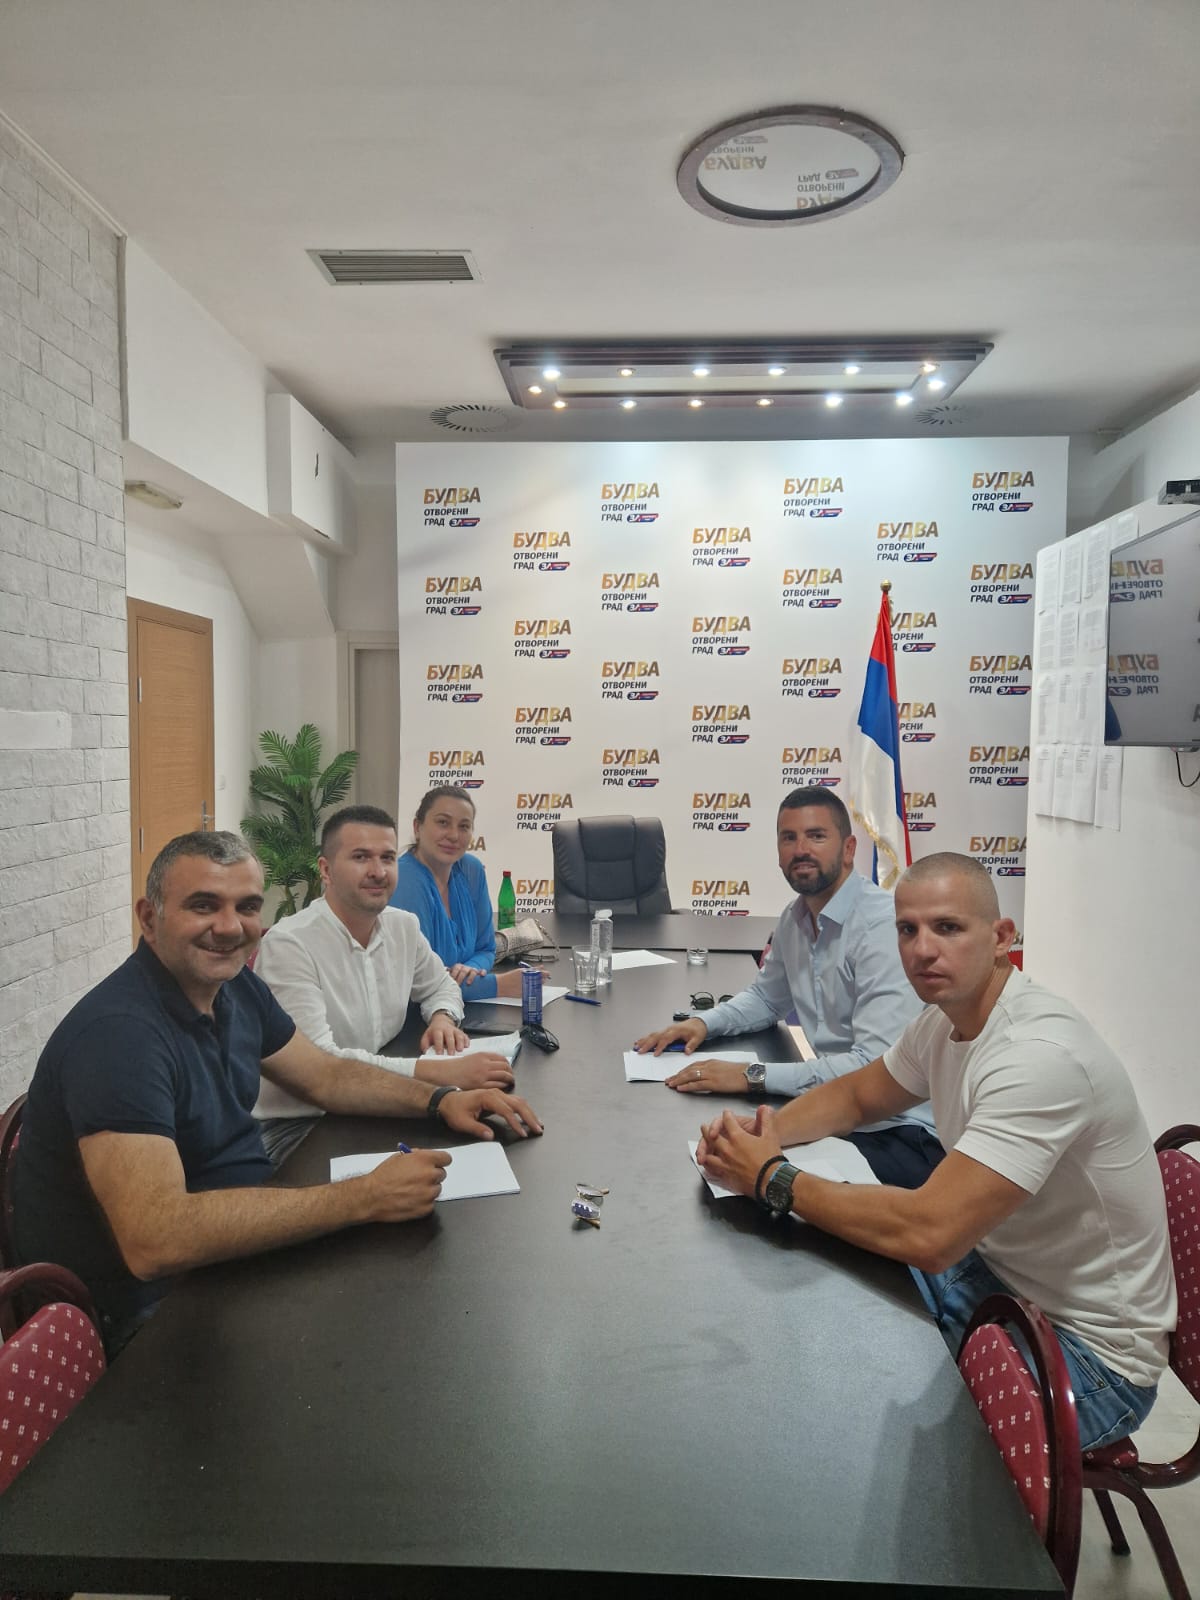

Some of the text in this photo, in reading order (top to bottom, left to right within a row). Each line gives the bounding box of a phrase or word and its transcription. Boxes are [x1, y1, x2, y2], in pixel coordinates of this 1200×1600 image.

[973, 471, 1034, 491] БУДВА
[784, 477, 843, 497] БУДВА
[424, 487, 481, 507] БУДВА
[601, 483, 659, 502] БУДВА
[972, 492, 1021, 501] ОТВОРЕНИ
[784, 498, 830, 507] ОТВОРЕНИ
[424, 508, 468, 516] ОТВОРЕНИ
[601, 503, 647, 512] ОТВОРЕНИ
[972, 503, 994, 512] ГРАД
[601, 513, 622, 522] ГРАД
[784, 509, 805, 517] ГРАД
[424, 518, 445, 527] ГРАД
[877, 521, 938, 541] БУДВА
[513, 532, 570, 550] БУДВА
[692, 527, 751, 546] БУДВА
[877, 542, 925, 551] ОТВОРЕНИ
[513, 552, 558, 560] ОТВОРЕНИ
[693, 548, 738, 556] ОТВОРЕНИ
[877, 553, 899, 561] ГРАД
[513, 562, 534, 571] ГРАД
[692, 558, 714, 566] ГРАД
[783, 568, 843, 587] БУДВА
[971, 563, 1034, 583] БУДВА
[425, 576, 482, 595] БУДВА
[602, 573, 659, 592] БУДВА
[783, 589, 830, 597] ОТВОРЕНИ
[970, 584, 1019, 593] ОТВОРЕНИ
[426, 597, 470, 605] ОТВОРЕНИ
[601, 593, 647, 601] ОТВОРЕНИ
[970, 594, 993, 603] ГРАД
[601, 603, 623, 611] ГРАД
[783, 599, 804, 607] ГРАД
[426, 606, 446, 615] ГРАД
[692, 616, 751, 635] БУДВА
[891, 612, 937, 631] УДВА
[514, 620, 571, 638] БУДВА
[692, 636, 738, 645] ОТВОРЕНИ
[892, 632, 924, 641] ОРЕНИ
[514, 649, 535, 658] ГРАД
[692, 646, 713, 655] ГРАД
[782, 658, 842, 677] БУДВА
[970, 655, 1032, 674] БУДВА
[427, 664, 483, 683] БУДВА
[602, 661, 659, 680] БУДВА
[782, 678, 829, 687] ОТВОРЕНИ
[969, 675, 1019, 684] ОТВОРЕНИ
[427, 684, 471, 692] ОТВОРЕНИ
[602, 681, 647, 689] ОТВОРЕНИ
[782, 688, 803, 697] ГРАД
[969, 686, 992, 694] ГРАД
[427, 693, 448, 702] ГРАД
[602, 691, 623, 699] ГРАД
[692, 705, 750, 724] БУДВА
[898, 702, 936, 721] ДВА
[515, 707, 572, 726] БУДВА
[515, 727, 560, 735] ОТВОРЕНИ
[692, 725, 738, 733] ОТВОРЕНИ
[515, 736, 536, 744] ГРАД
[692, 734, 713, 743] ГРАД
[429, 750, 484, 769] БУДВА
[603, 749, 660, 767] БУДВА
[782, 747, 842, 766] БУДВА
[969, 746, 1030, 765] БУДВА
[429, 770, 472, 778] ОТВОРЕНИ
[969, 766, 1018, 774] ОТВОРЕНИ
[603, 778, 623, 786] ГРАД
[782, 777, 804, 786] ГРАД
[969, 776, 992, 785] ГРАД
[517, 794, 573, 811] БУДВА
[693, 793, 751, 811] БУДВА
[517, 822, 537, 831] ГРАД
[693, 822, 714, 831] ГРАД
[516, 880, 555, 898] БУД
[692, 880, 749, 898] БУДВА
